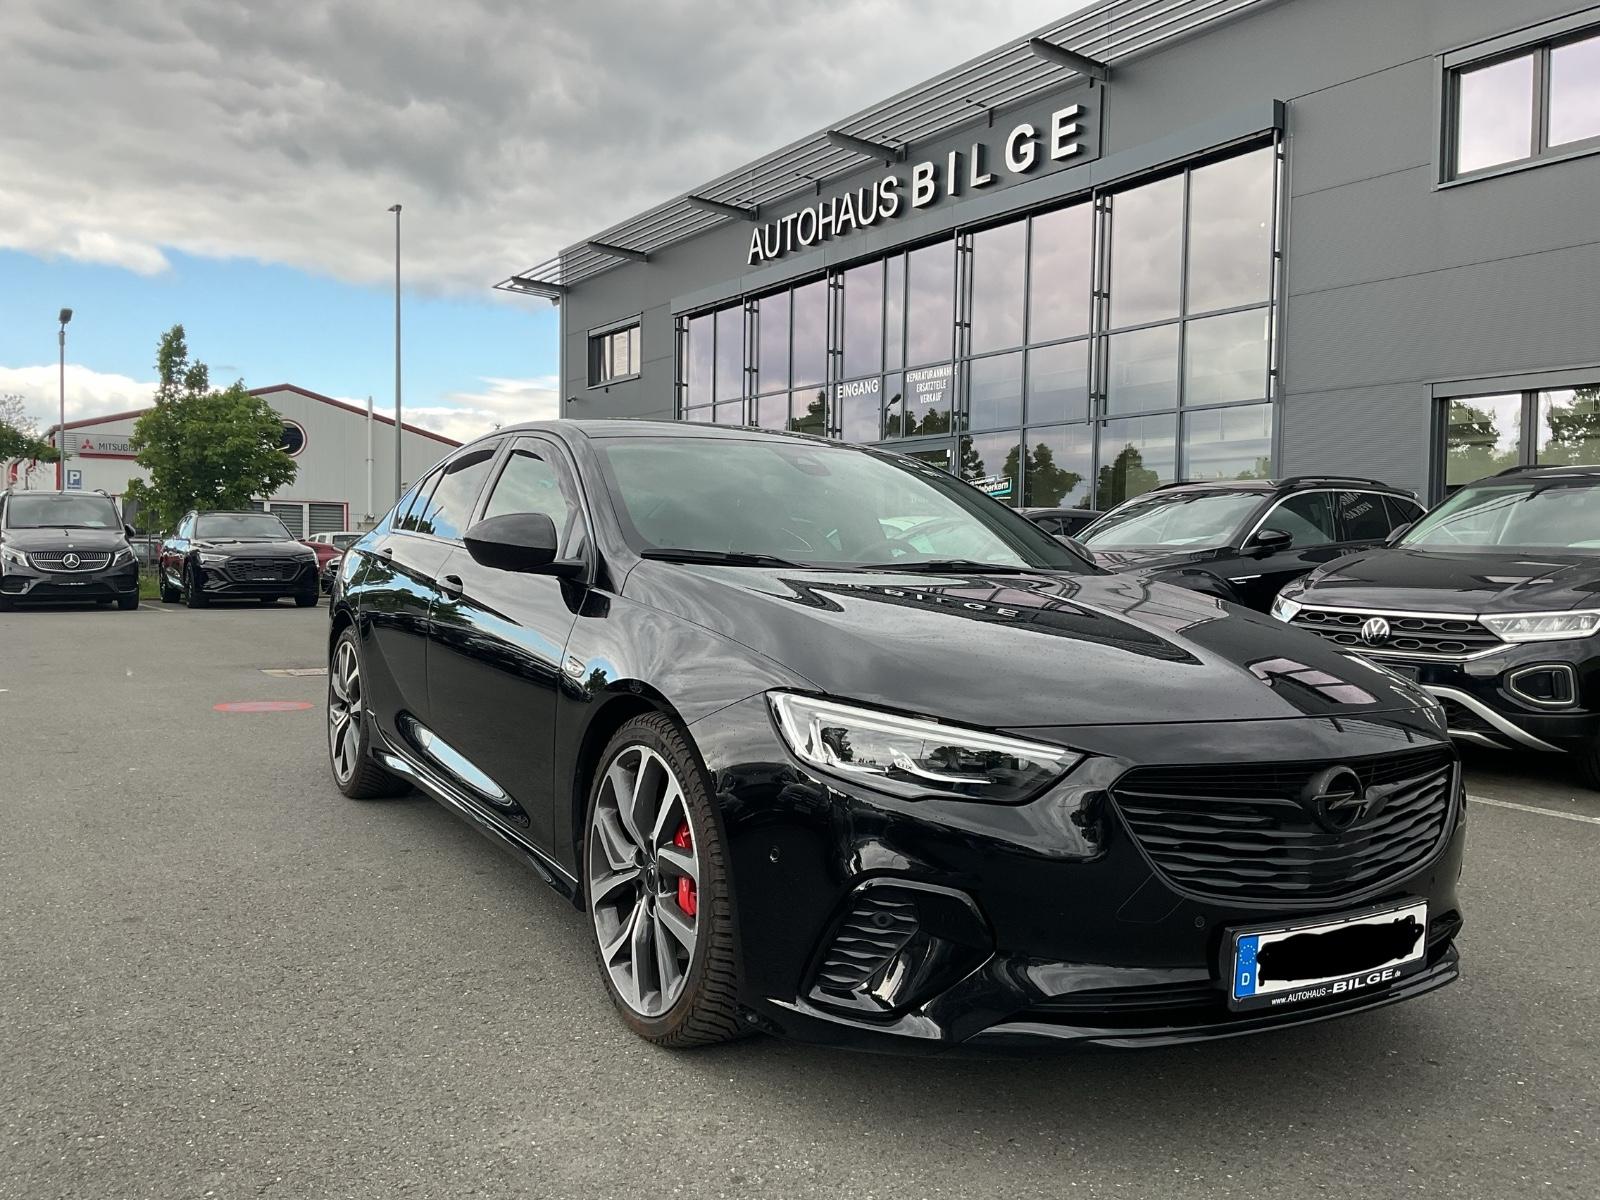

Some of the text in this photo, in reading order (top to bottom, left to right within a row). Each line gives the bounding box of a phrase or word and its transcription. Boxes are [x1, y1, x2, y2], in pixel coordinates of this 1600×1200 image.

[747, 103, 1080, 265] AUTOHAUS BILGE
[837, 379, 879, 399] EINGANG
[916, 379, 947, 393] ERSATZTEILE
[920, 391, 943, 404] VERKAUF
[98, 442, 145, 452] MITSUBI
[69, 470, 80, 484] P
[1241, 973, 1251, 986] D
